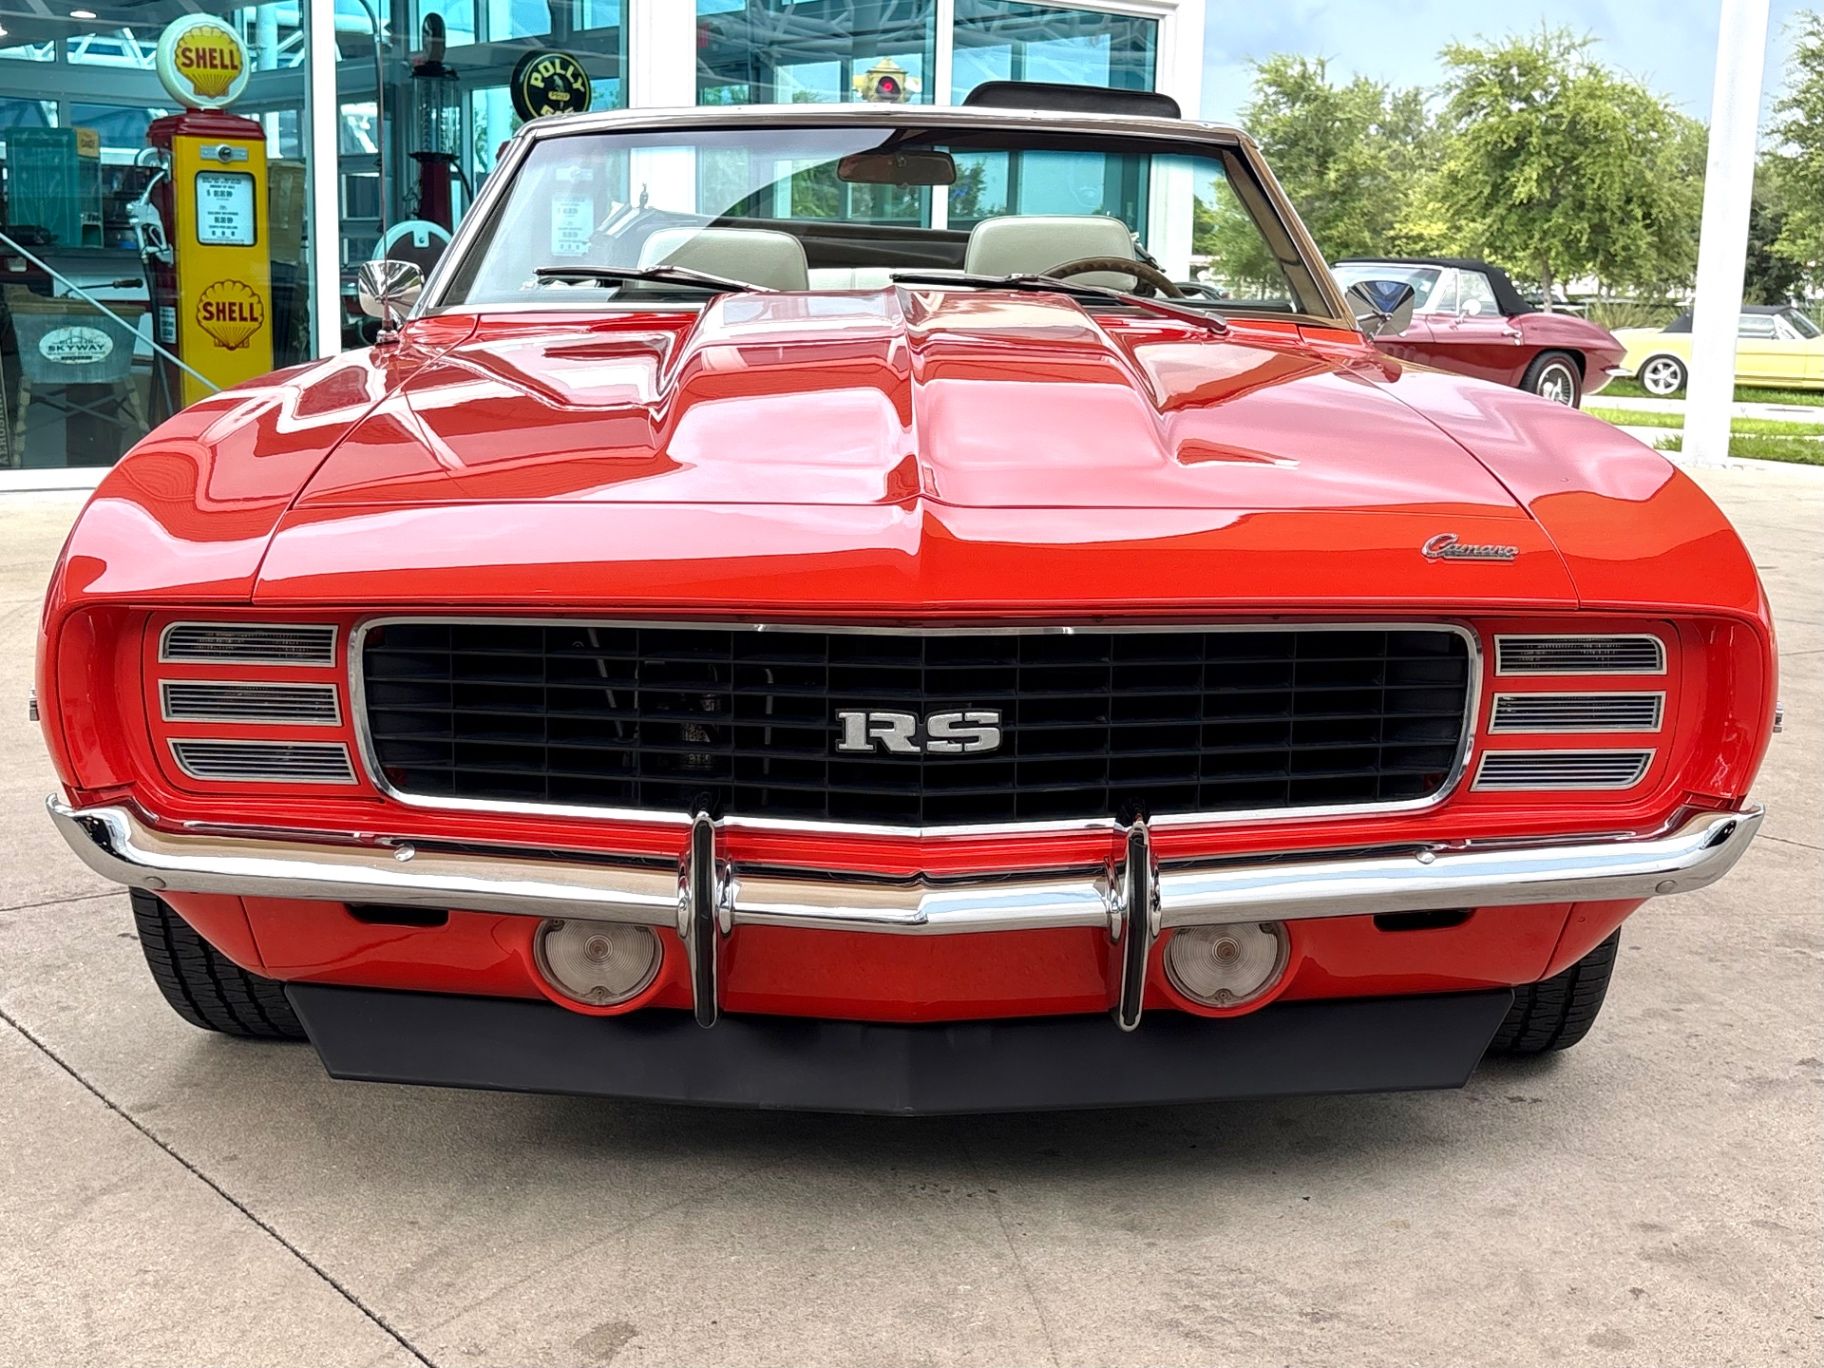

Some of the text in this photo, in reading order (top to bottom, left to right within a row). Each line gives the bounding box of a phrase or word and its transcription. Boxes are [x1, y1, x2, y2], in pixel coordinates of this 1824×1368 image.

[181, 46, 239, 70] SHELL
[530, 58, 585, 92] POLLY
[202, 301, 259, 322] SHELL
[48, 344, 104, 352] SKYWAY
[1421, 532, 1520, 559] Camaro
[837, 711, 1001, 752] RS
